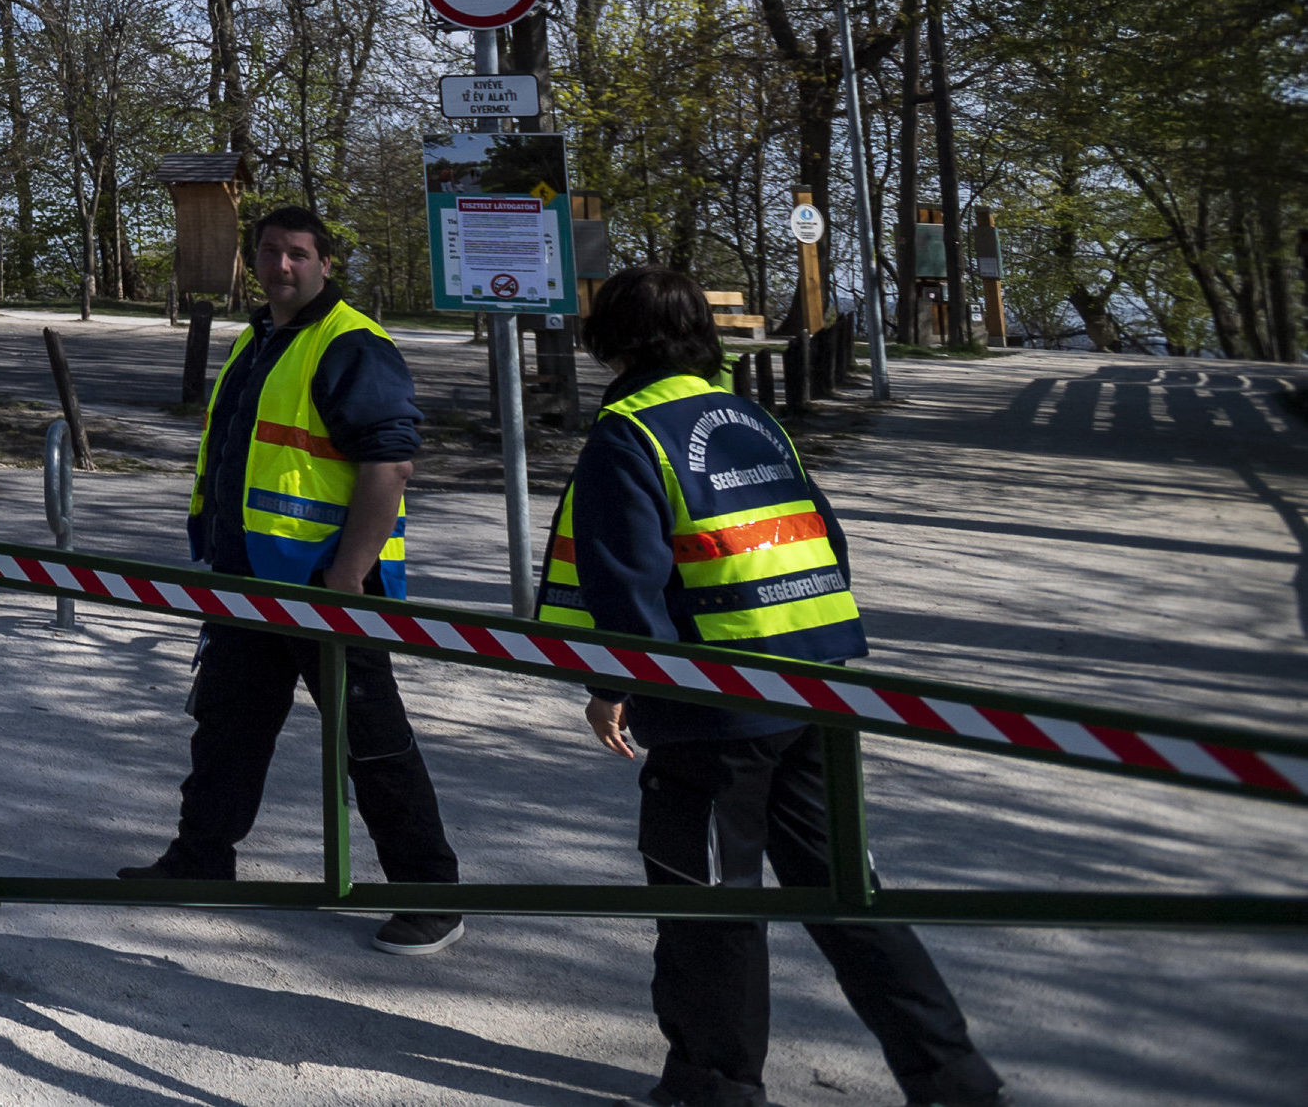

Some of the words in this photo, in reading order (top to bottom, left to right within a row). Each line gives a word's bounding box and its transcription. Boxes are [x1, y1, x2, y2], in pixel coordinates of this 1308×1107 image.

[473, 79, 503, 90] KIVÉVE
[462, 93, 471, 102] 12
[473, 91, 484, 102] ÉV
[488, 93, 518, 102] ALATTI
[470, 105, 511, 114] GYERMEK
[461, 202, 492, 210] TISZTELT
[688, 409, 729, 473] HEGYVIDÉKI
[709, 461, 795, 491] SEGÉDFELÜGYELŐ
[756, 568, 847, 604] SEGÉDFELÜGYELŐ
